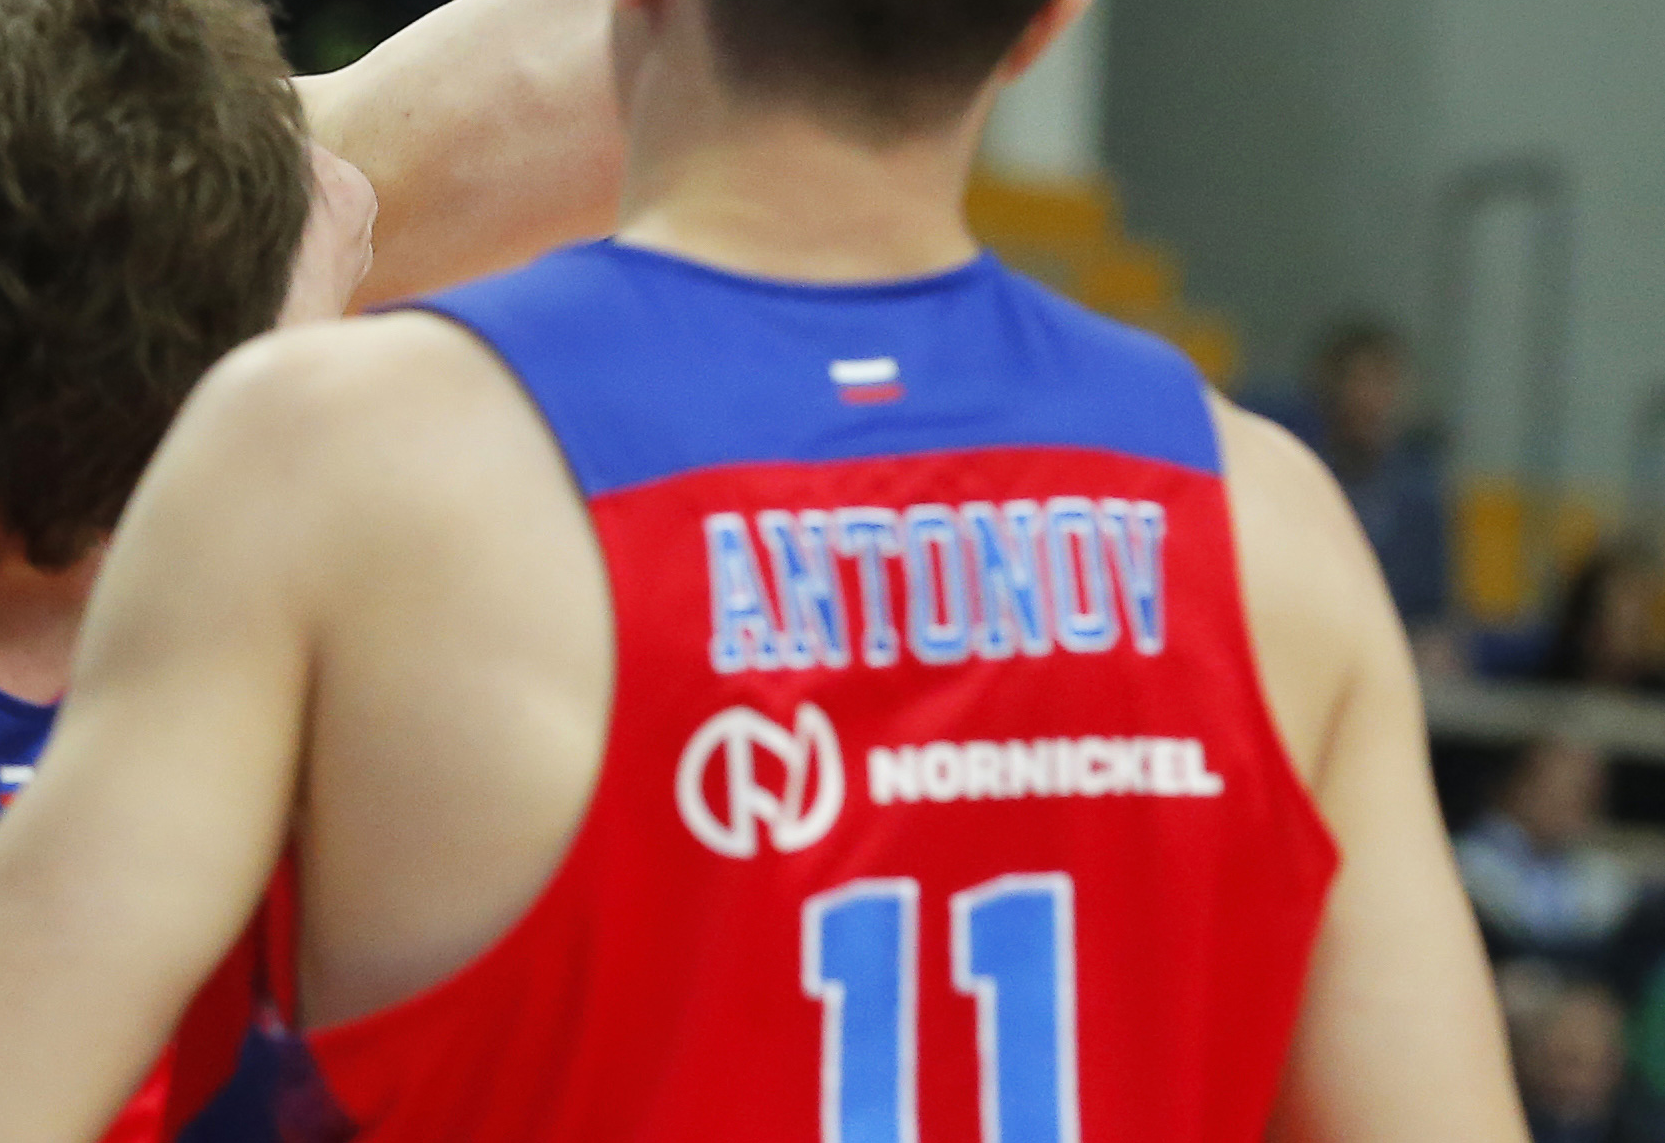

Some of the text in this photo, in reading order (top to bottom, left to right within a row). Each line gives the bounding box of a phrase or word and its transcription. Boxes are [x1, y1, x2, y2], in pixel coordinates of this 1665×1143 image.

[703, 496, 1166, 674] ANTONOV
[866, 735, 1224, 805] NORNICKEL
[801, 871, 1083, 1143] 11
